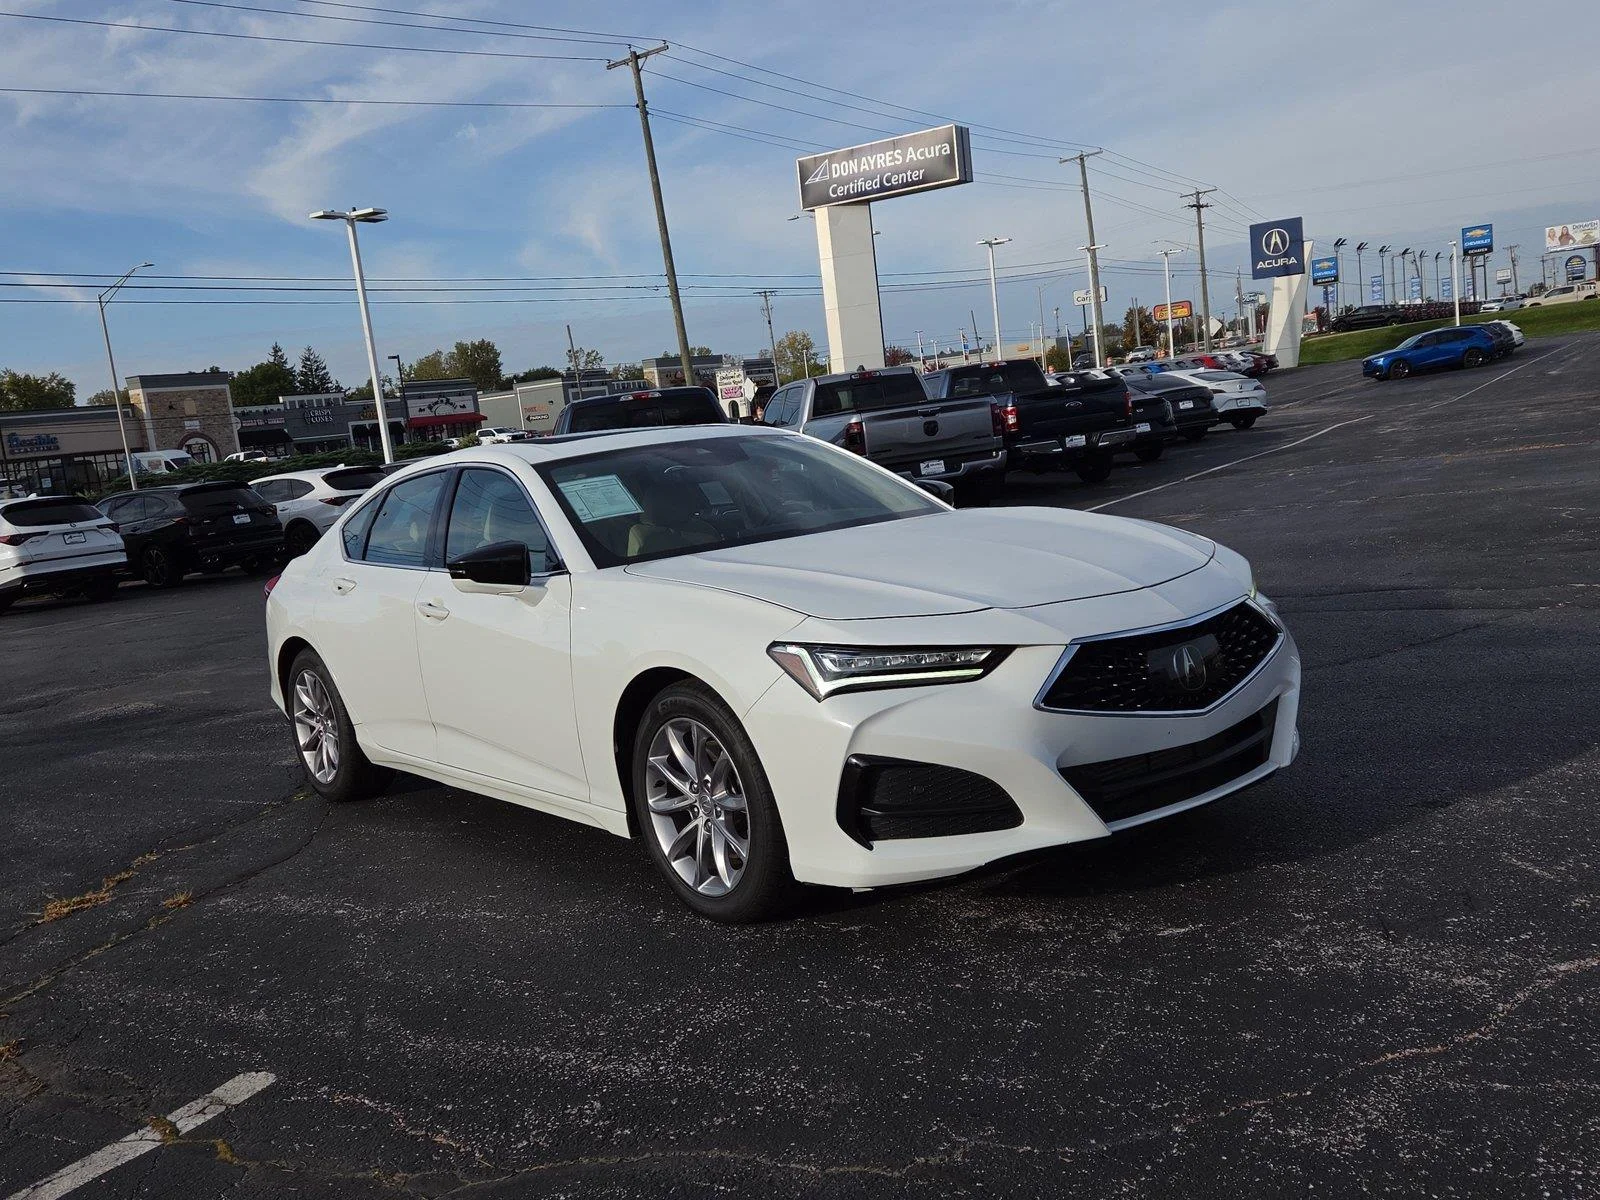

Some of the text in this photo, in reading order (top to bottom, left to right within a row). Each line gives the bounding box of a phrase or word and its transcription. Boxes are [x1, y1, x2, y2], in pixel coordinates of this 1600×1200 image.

[831, 142, 951, 179] DON AYRES Acura
[829, 168, 925, 198] Certified Center
[1256, 256, 1298, 270] ACURA
[310, 408, 333, 417] CRISPY
[311, 415, 333, 424] CONES
